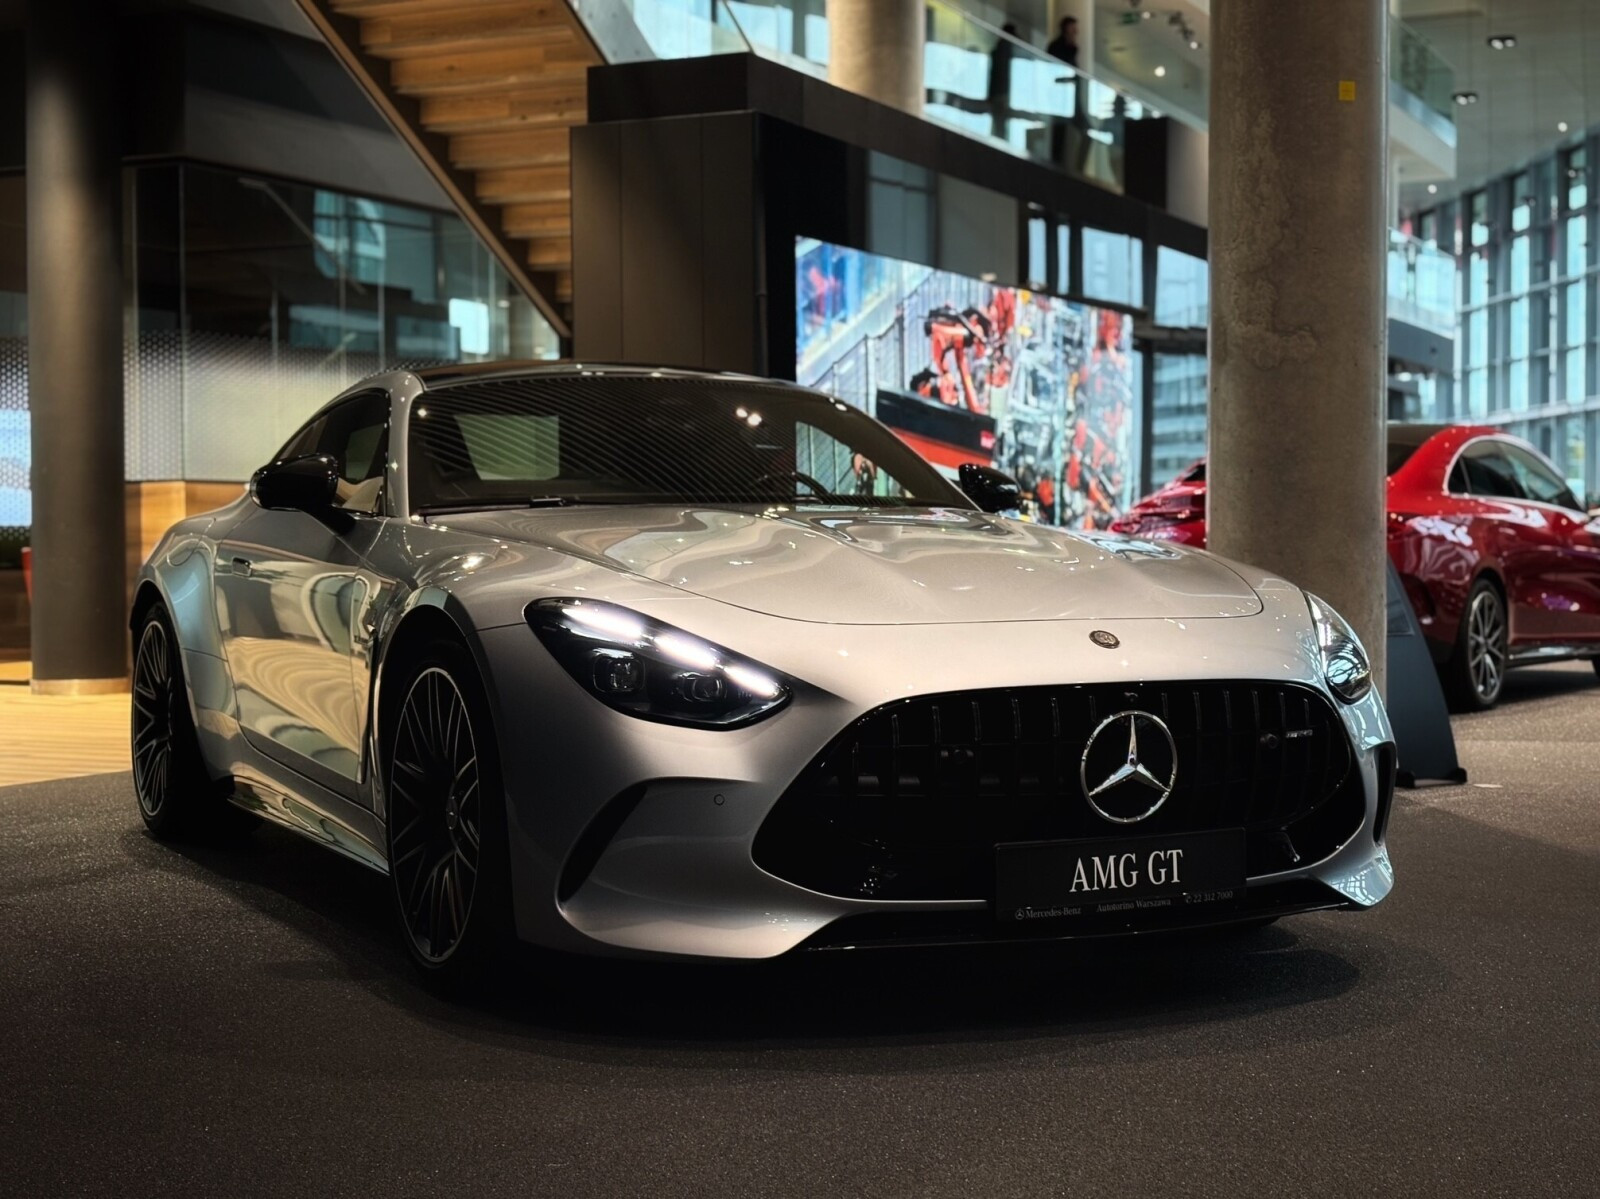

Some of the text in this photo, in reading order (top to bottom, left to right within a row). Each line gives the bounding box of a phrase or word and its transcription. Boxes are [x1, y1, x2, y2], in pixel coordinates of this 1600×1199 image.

[1069, 849, 1184, 893] AMG GT
[1025, 906, 1082, 919] Mercedes-Benz
[1096, 902, 1135, 913] Autotorino
[1135, 898, 1172, 909] Warszawa
[1193, 894, 1202, 903] 22
